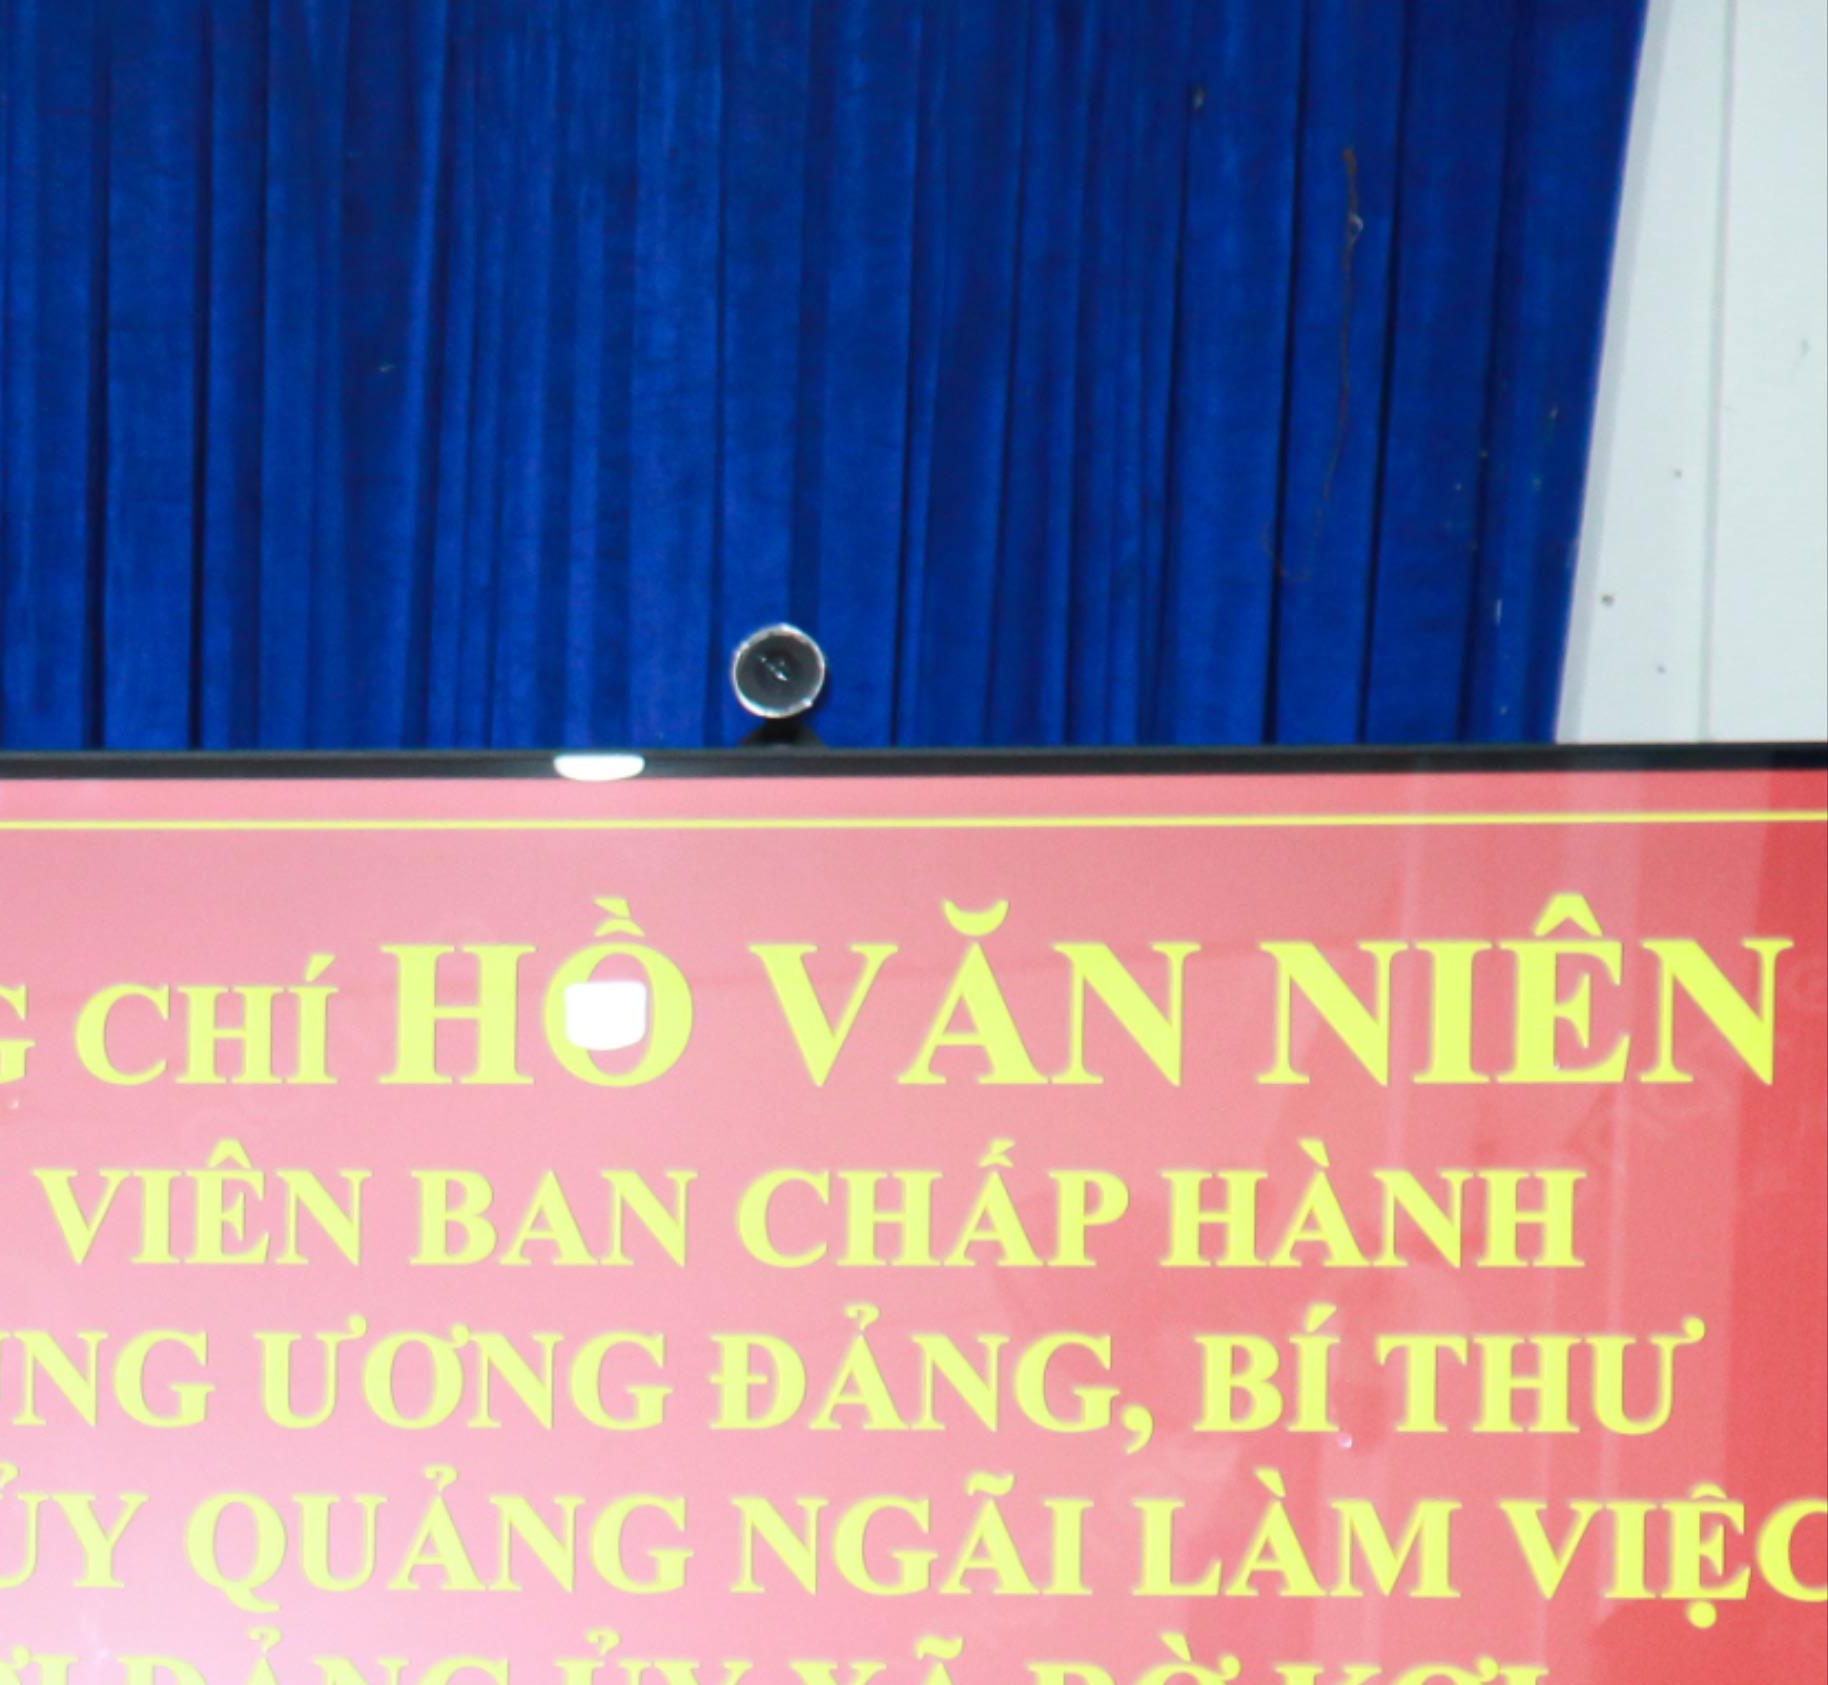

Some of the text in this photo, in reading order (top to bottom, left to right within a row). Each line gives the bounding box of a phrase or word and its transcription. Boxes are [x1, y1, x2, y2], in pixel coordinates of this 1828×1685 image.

[74, 954, 339, 1086] CHÍ
[378, 897, 693, 1088] HỒ
[749, 900, 1201, 1087] VĂN
[1257, 893, 1794, 1087] NIÊN
[32, 1139, 372, 1266] VIÊN
[408, 1167, 698, 1267] BAN
[736, 1139, 1129, 1268] CHẤP
[1159, 1139, 1587, 1268] HÀNH
[255, 1314, 673, 1430] ƯƠNG
[708, 1303, 1154, 1455] ĐẢNG,
[1193, 1302, 1342, 1434] BÍ
[1378, 1316, 1705, 1436] THƯ
[185, 1464, 696, 1613] QUẢNG
[730, 1473, 1094, 1597] NGÃI
[1132, 1467, 1463, 1600] LÀM
[1499, 1483, 1828, 1629] VIỆC
